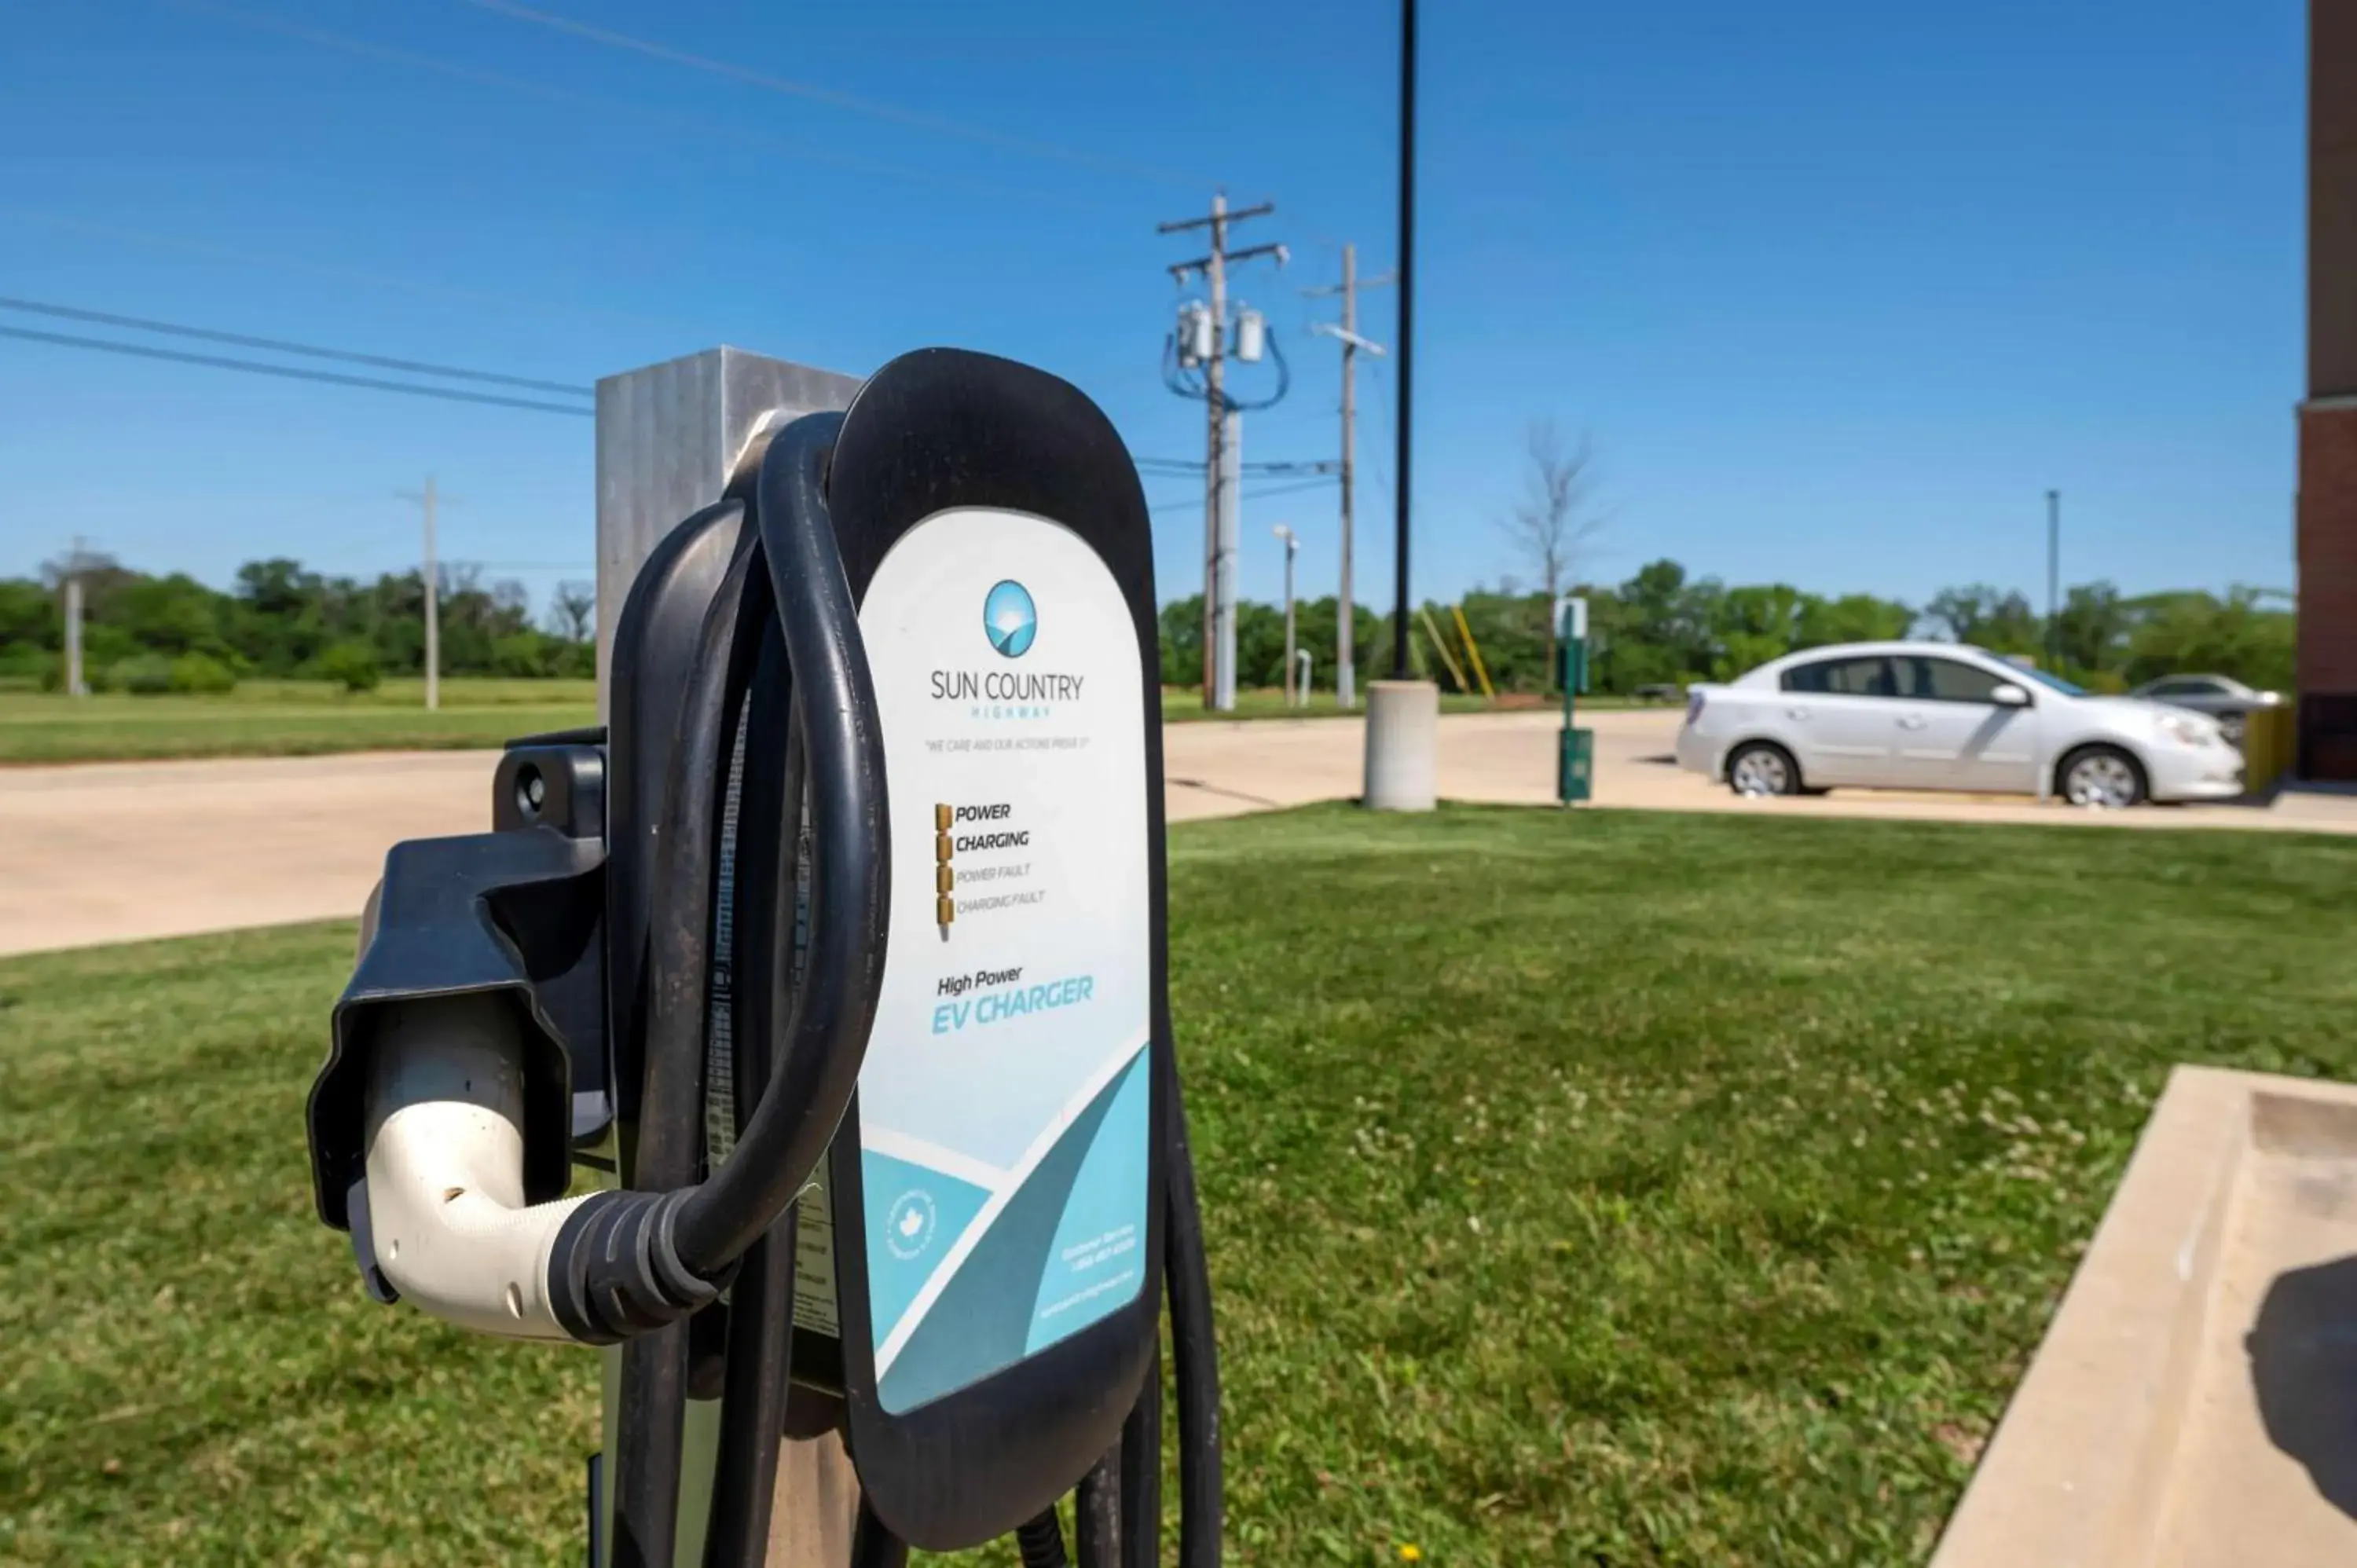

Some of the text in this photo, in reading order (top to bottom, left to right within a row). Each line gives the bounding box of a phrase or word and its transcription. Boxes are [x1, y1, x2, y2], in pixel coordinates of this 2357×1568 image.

[931, 670, 1084, 701] SUN COUNTRY
[971, 705, 1050, 720] HIGHWAY
[955, 804, 1011, 822] POWER
[956, 830, 1030, 852] CHARGING
[956, 863, 1032, 884] POWER FAULT
[956, 889, 1046, 914] CHARGING FAULT
[937, 967, 1023, 997] High Power
[932, 975, 1094, 1035] EV CHARGER
